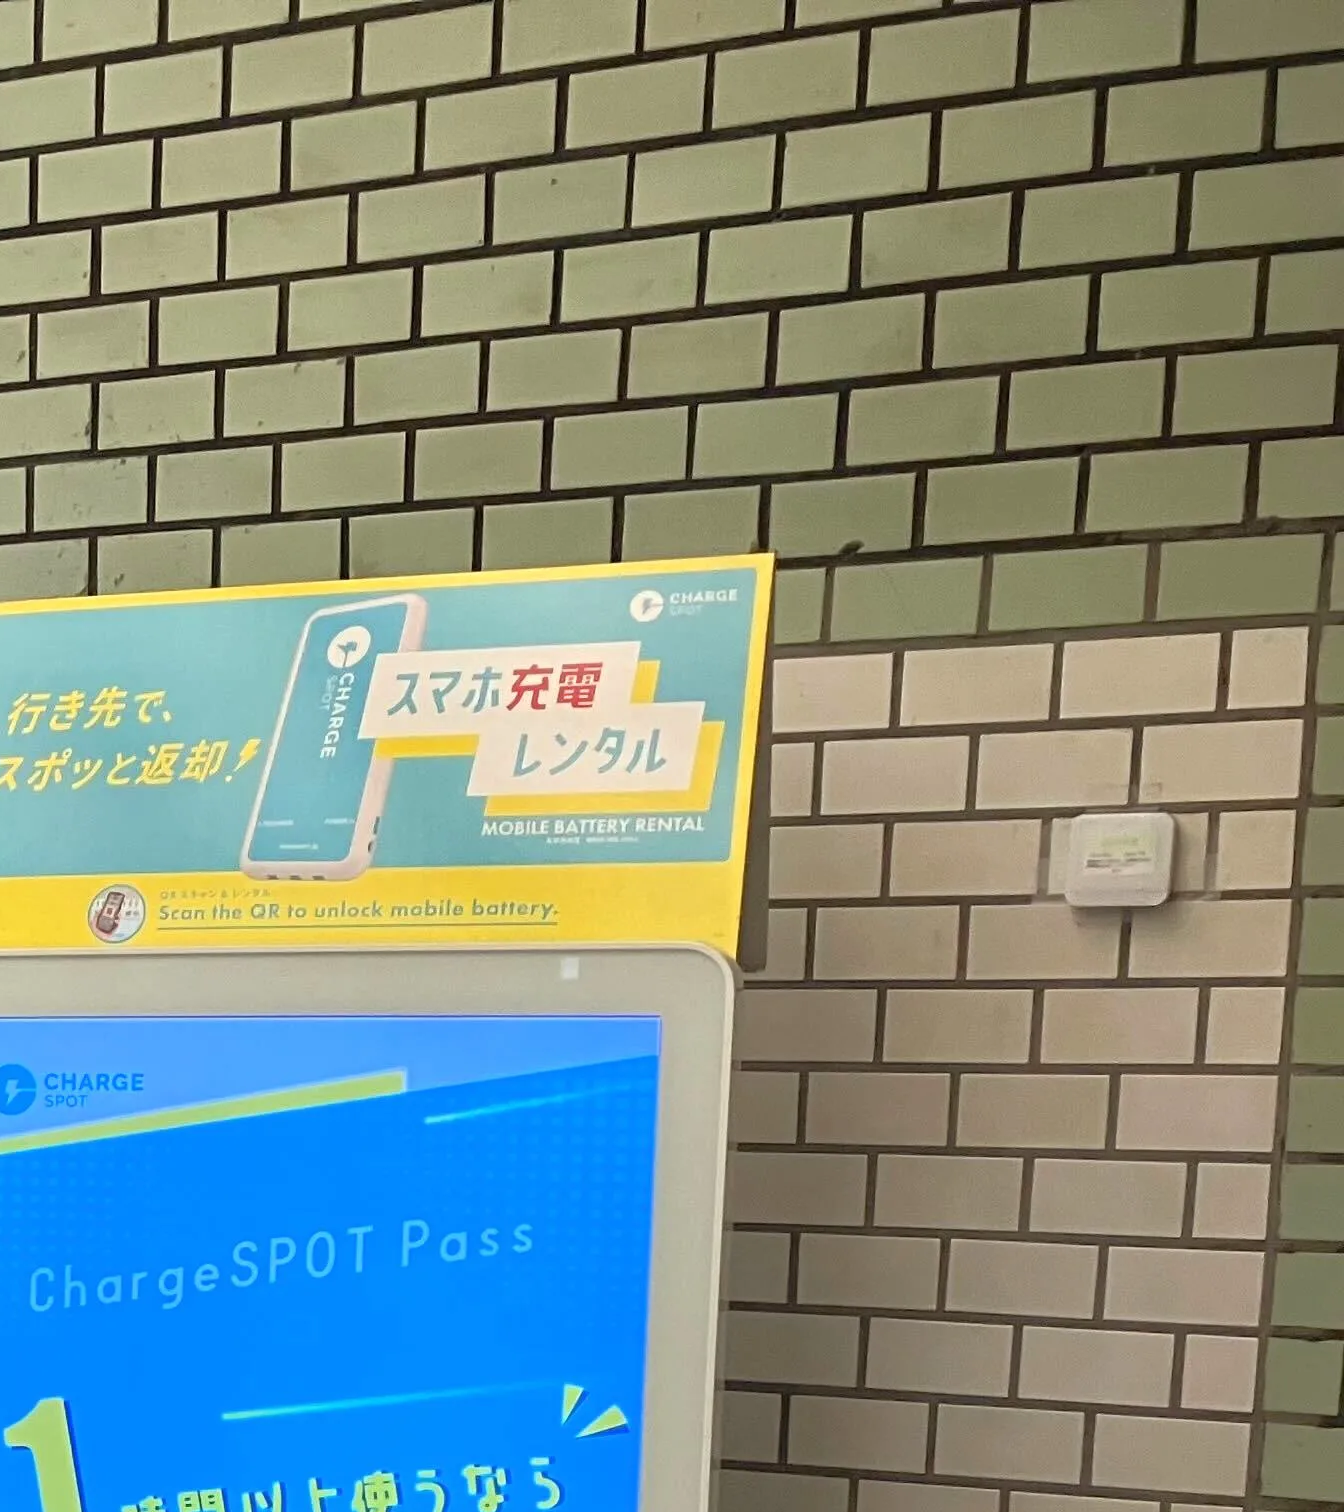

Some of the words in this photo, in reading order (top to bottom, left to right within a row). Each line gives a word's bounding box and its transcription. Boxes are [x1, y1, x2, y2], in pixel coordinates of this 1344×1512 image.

[670, 589, 738, 604] CHARGE
[386, 662, 603, 716] スマホ充電
[320, 672, 354, 759] CHARGE
[513, 724, 666, 779] レンタル
[482, 821, 549, 836] MOBILE
[554, 818, 630, 834] BATTERY
[636, 816, 705, 832] RENTAL
[159, 904, 205, 921] Scan
[213, 904, 242, 920] the
[251, 903, 279, 921] QR
[288, 903, 307, 919] to
[315, 901, 383, 918] unlock
[392, 899, 463, 917] mobile
[472, 899, 559, 921] battery.
[44, 1072, 144, 1093] CHARGE
[44, 1094, 88, 1108] SPOT
[29, 1225, 374, 1312] ChargeSPOT
[401, 1219, 535, 1267] Pass
